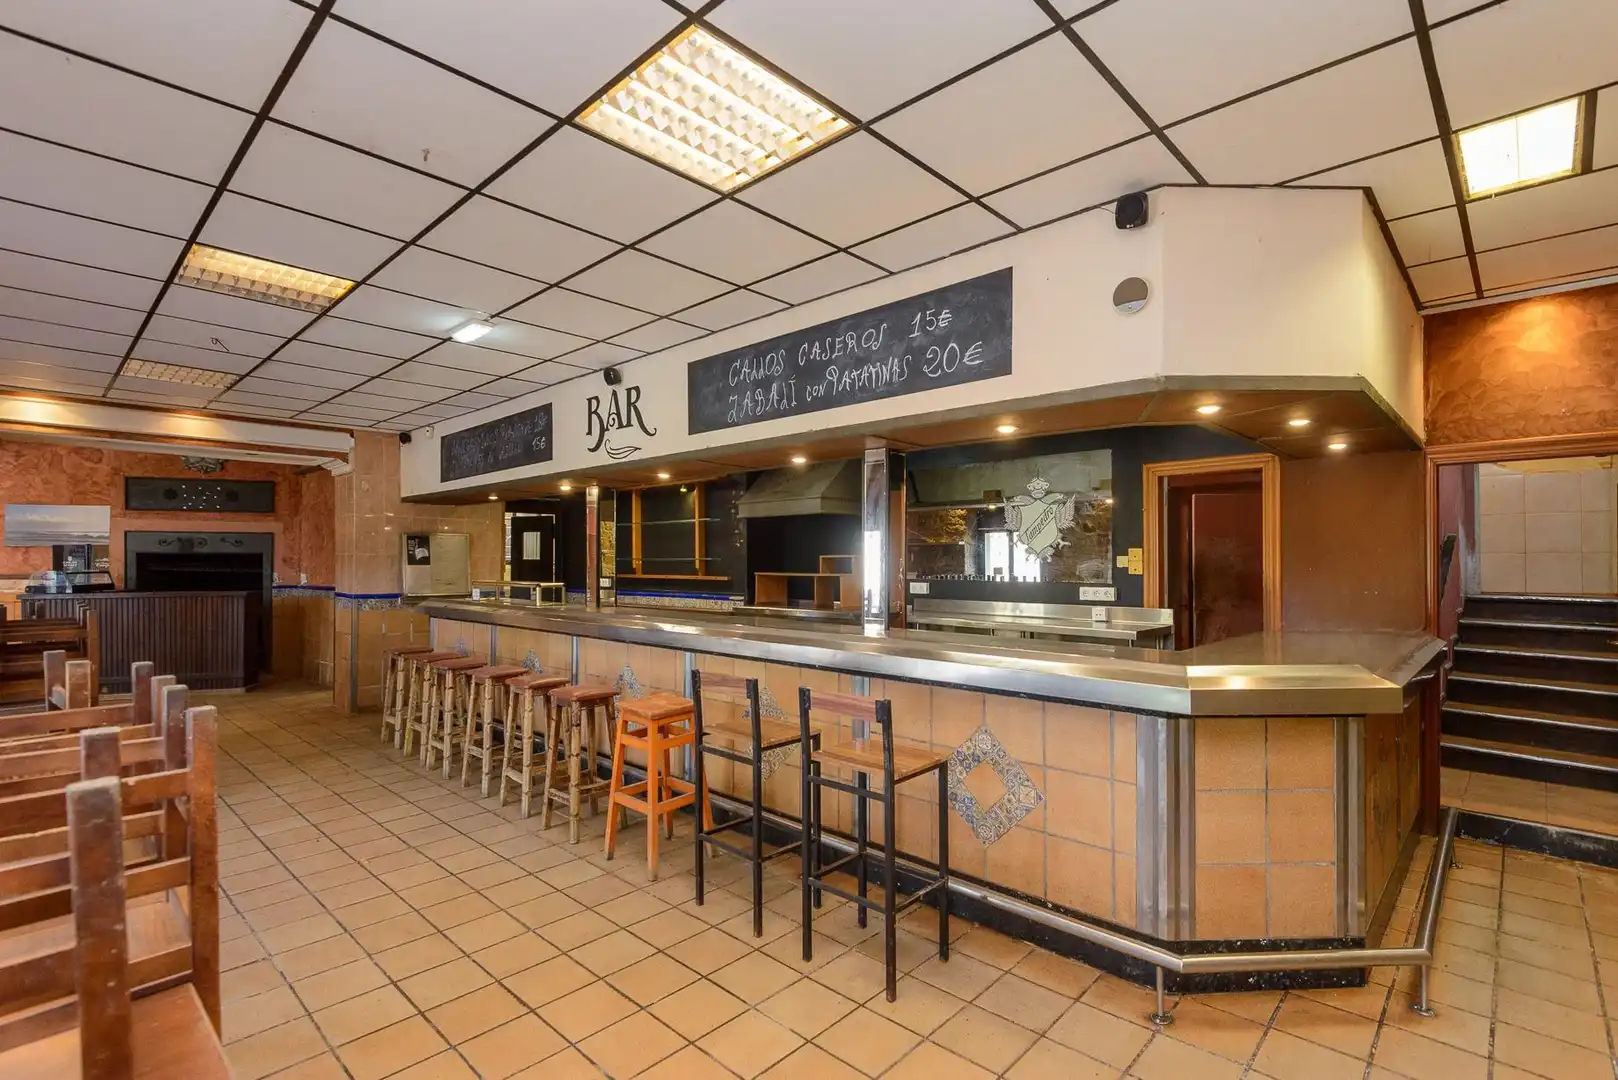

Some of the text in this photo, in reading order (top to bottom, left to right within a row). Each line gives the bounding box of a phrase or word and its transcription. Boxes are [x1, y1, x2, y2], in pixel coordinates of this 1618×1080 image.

[798, 323, 887, 367] CASEROS
[908, 308, 954, 339] 15€
[922, 341, 984, 378] 20€
[585, 385, 657, 453] BAR
